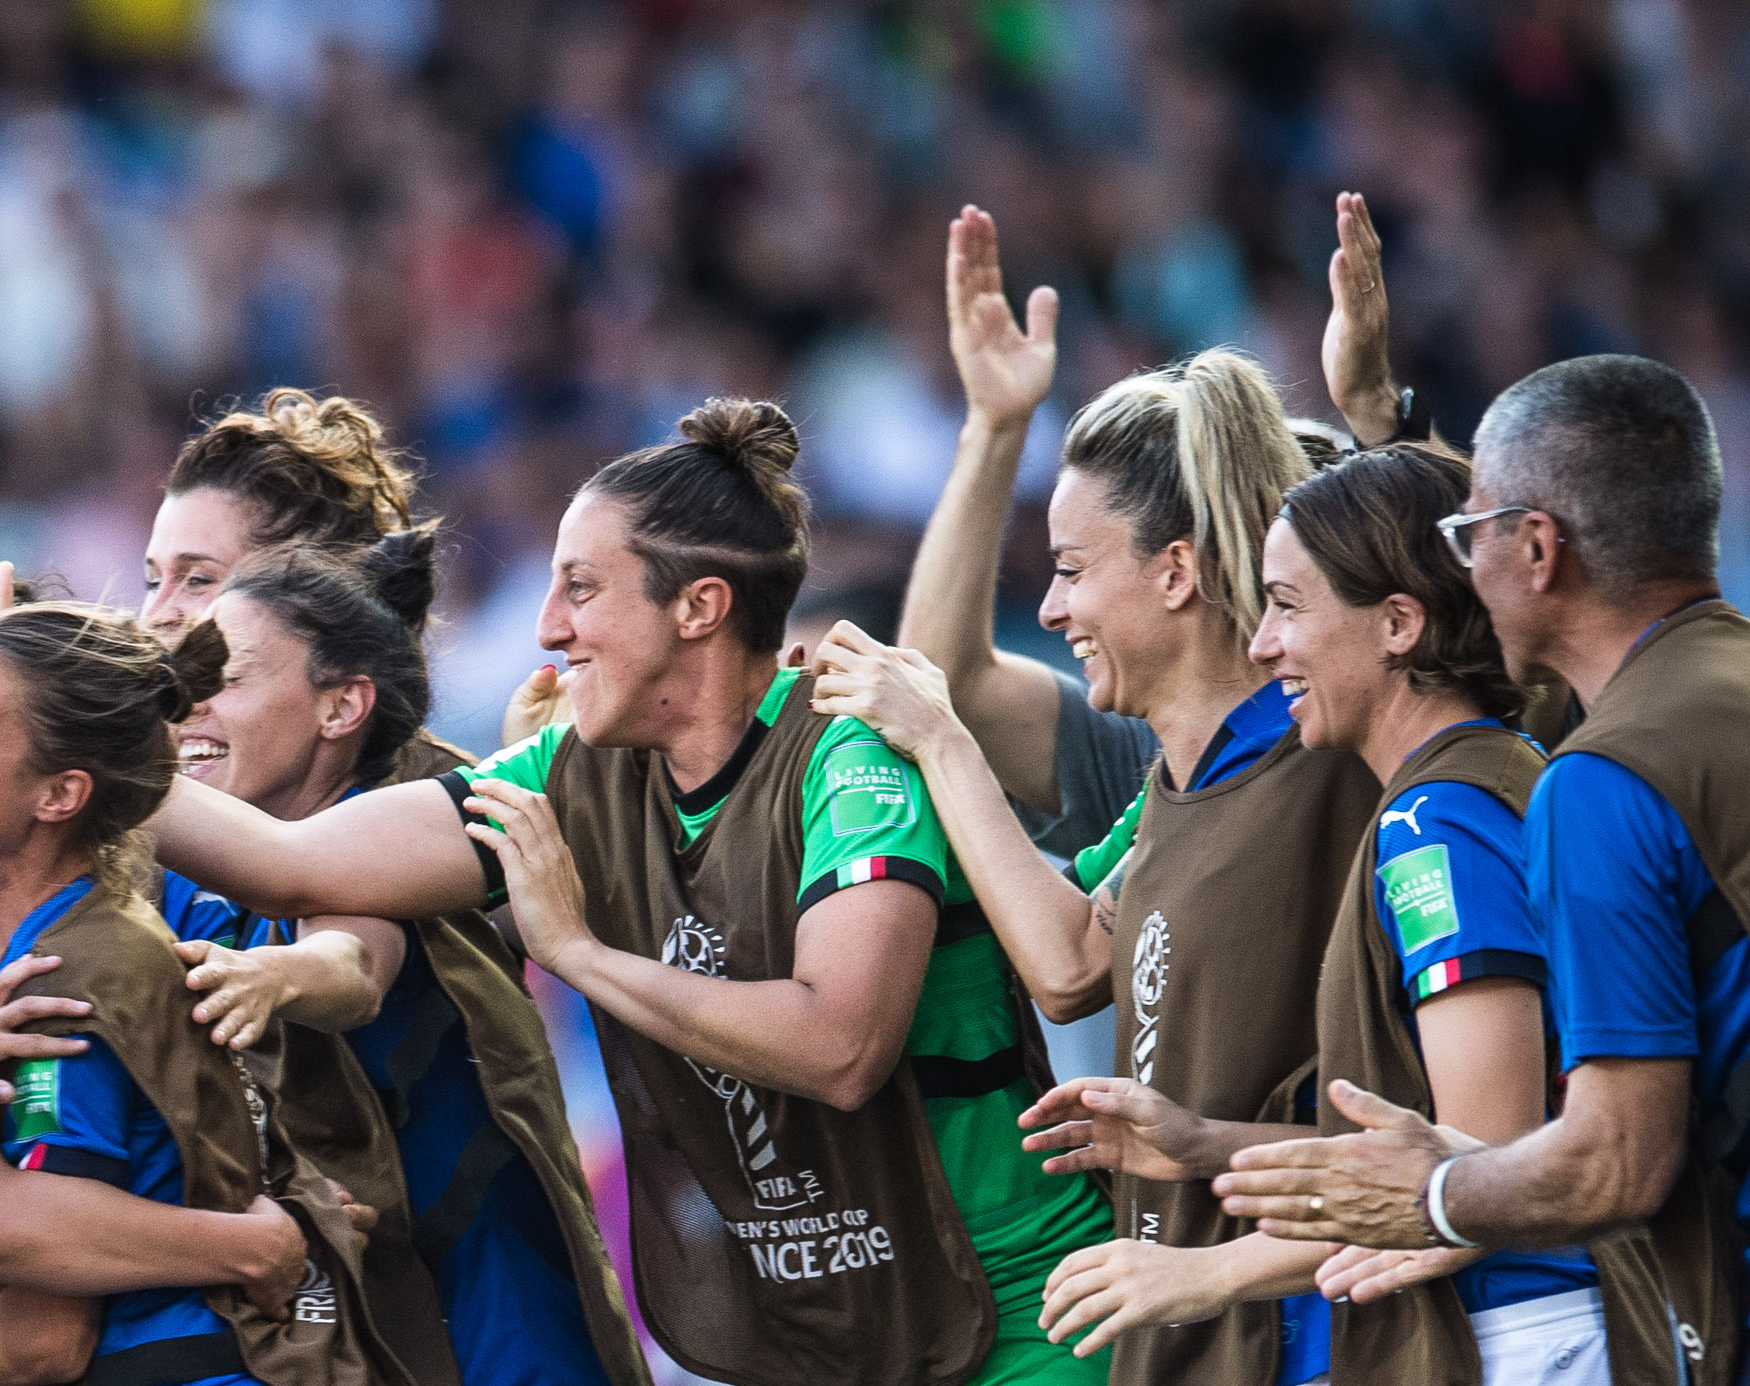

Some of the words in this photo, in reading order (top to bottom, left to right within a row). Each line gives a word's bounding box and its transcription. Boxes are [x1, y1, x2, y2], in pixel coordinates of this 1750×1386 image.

[833, 765, 901, 781] LIVING
[835, 774, 903, 788] FOOTBALL
[874, 793, 906, 805] FIFA
[754, 1176, 798, 1199] FIFA
[822, 1225, 895, 1274] 2019
